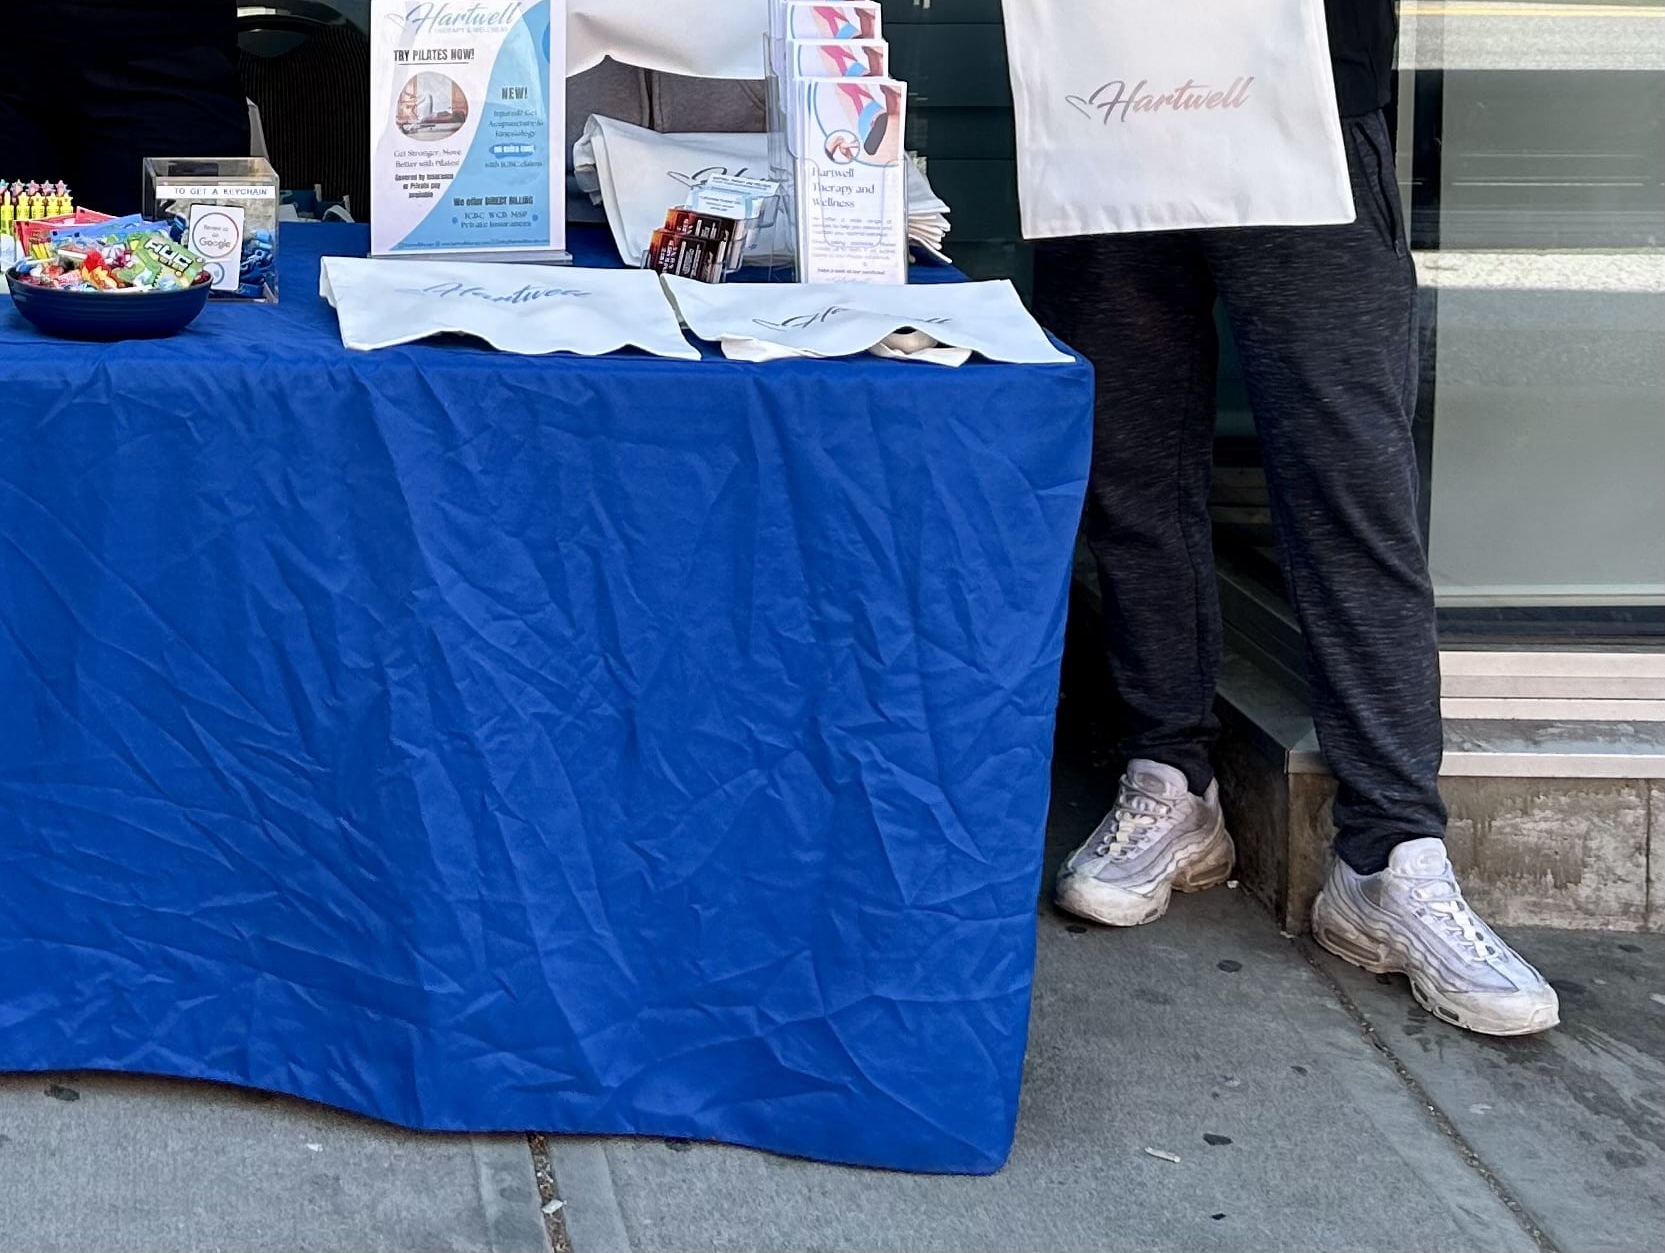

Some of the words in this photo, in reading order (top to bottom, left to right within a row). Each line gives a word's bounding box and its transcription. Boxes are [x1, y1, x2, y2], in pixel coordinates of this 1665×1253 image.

[405, 0, 523, 34] Hartwell
[393, 49, 410, 62] TRY
[412, 48, 448, 61] PILATES
[450, 48, 475, 61] NOW!
[501, 86, 528, 100] NEW!
[1089, 76, 1256, 126] Hartwell
[175, 187, 186, 195] TO
[190, 187, 207, 195] GET
[212, 187, 218, 195] A
[223, 188, 267, 196] KEYCHAIN
[813, 183, 853, 195] Therapy
[855, 184, 875, 194] and
[812, 197, 855, 208] Wellness
[199, 236, 231, 249] Google
